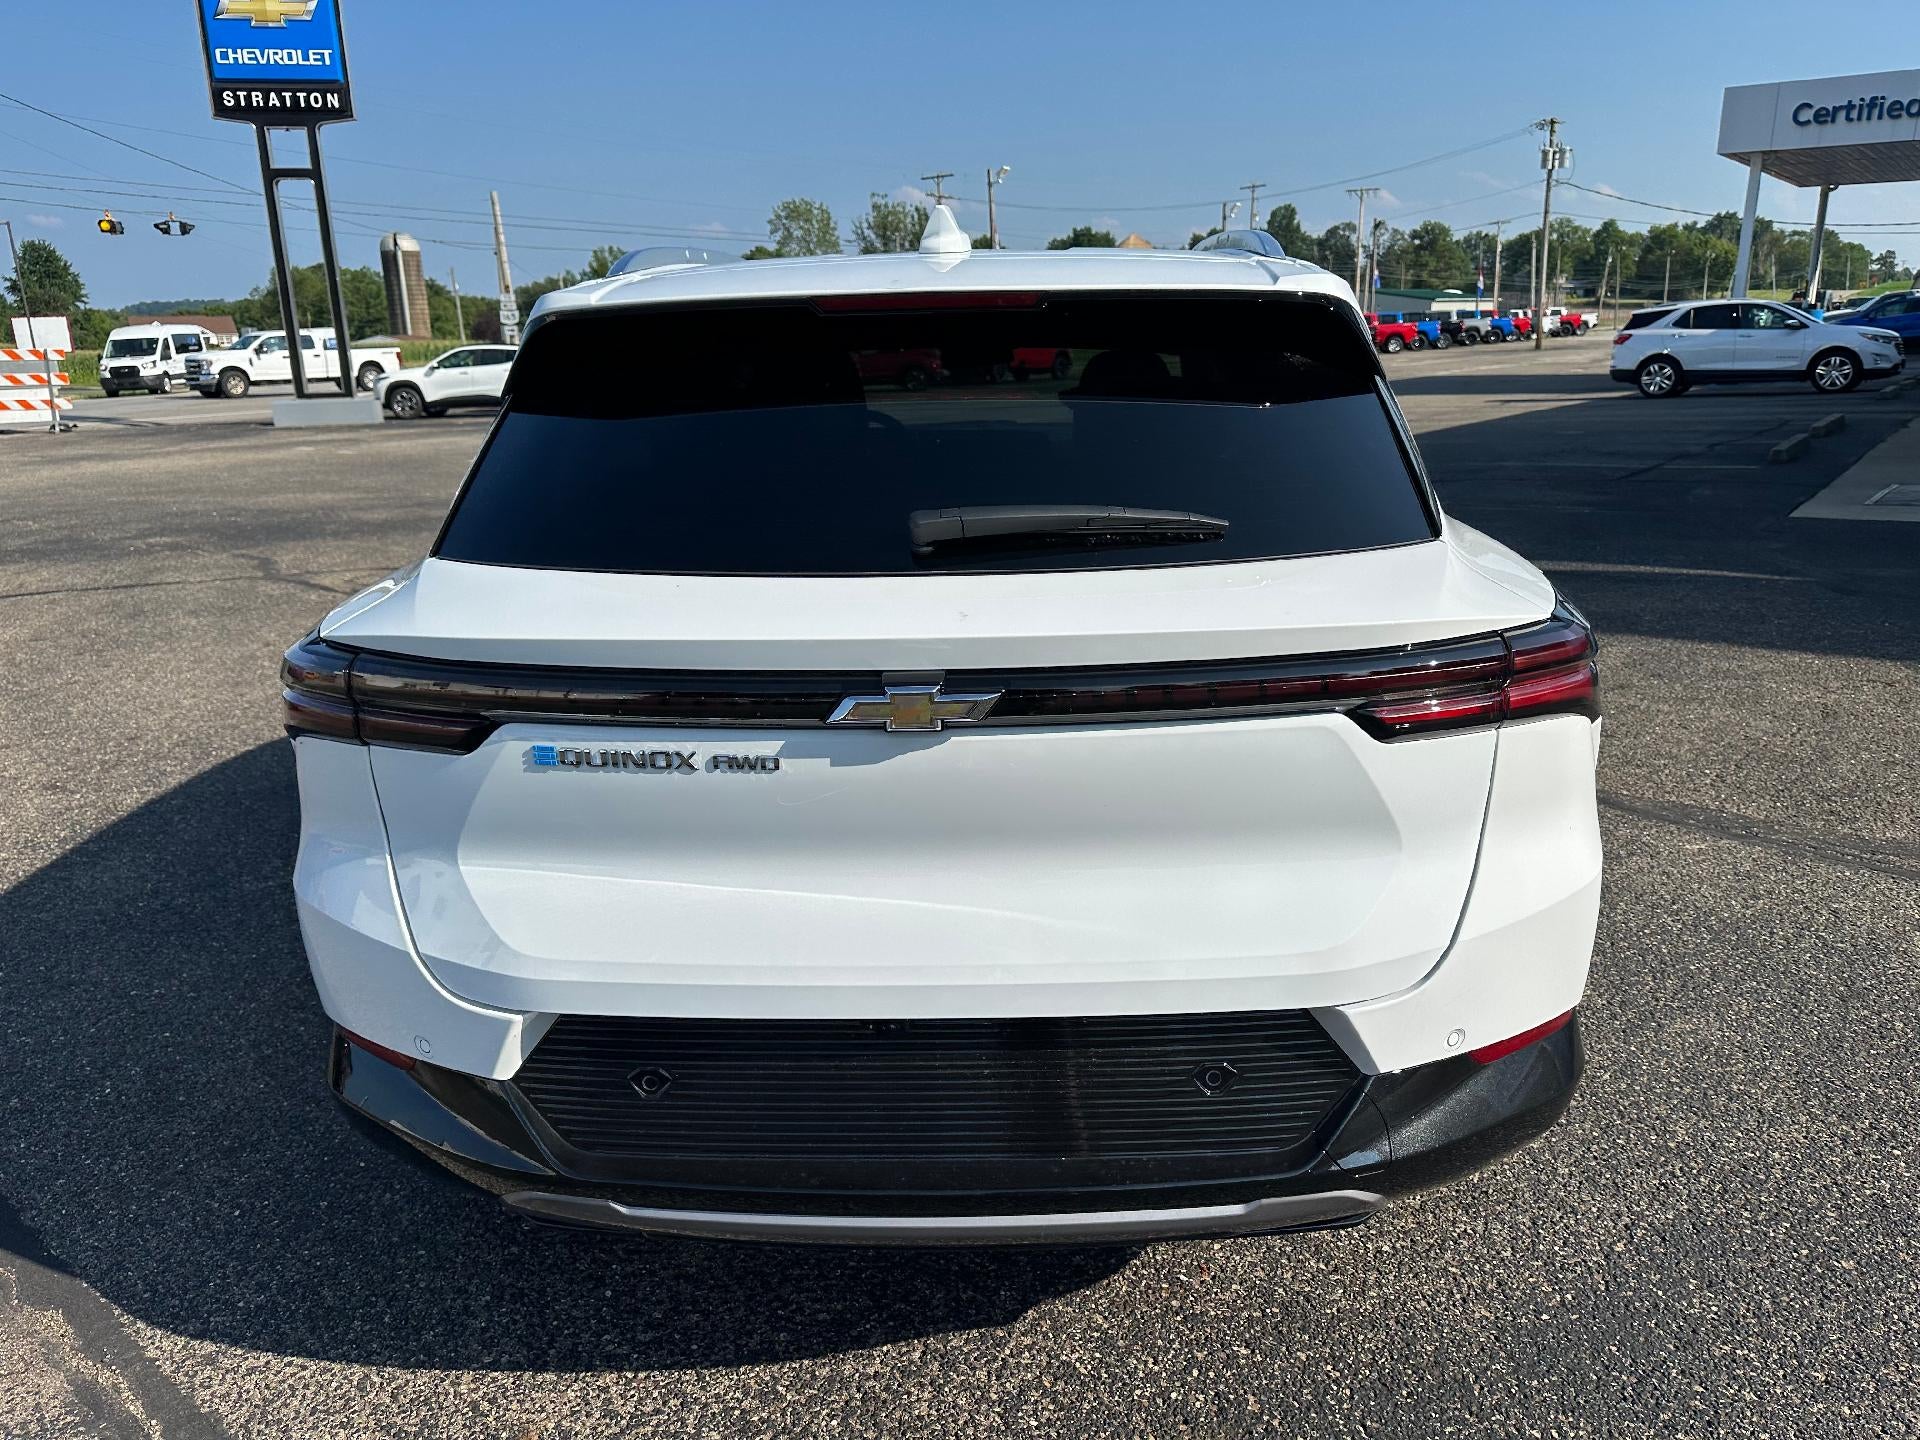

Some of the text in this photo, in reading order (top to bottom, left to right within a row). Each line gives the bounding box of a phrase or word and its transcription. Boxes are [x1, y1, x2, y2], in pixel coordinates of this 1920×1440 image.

[215, 48, 332, 65] CHEVROLET
[222, 90, 340, 108] STRATTON
[532, 744, 780, 771] EQUINOX AWD
